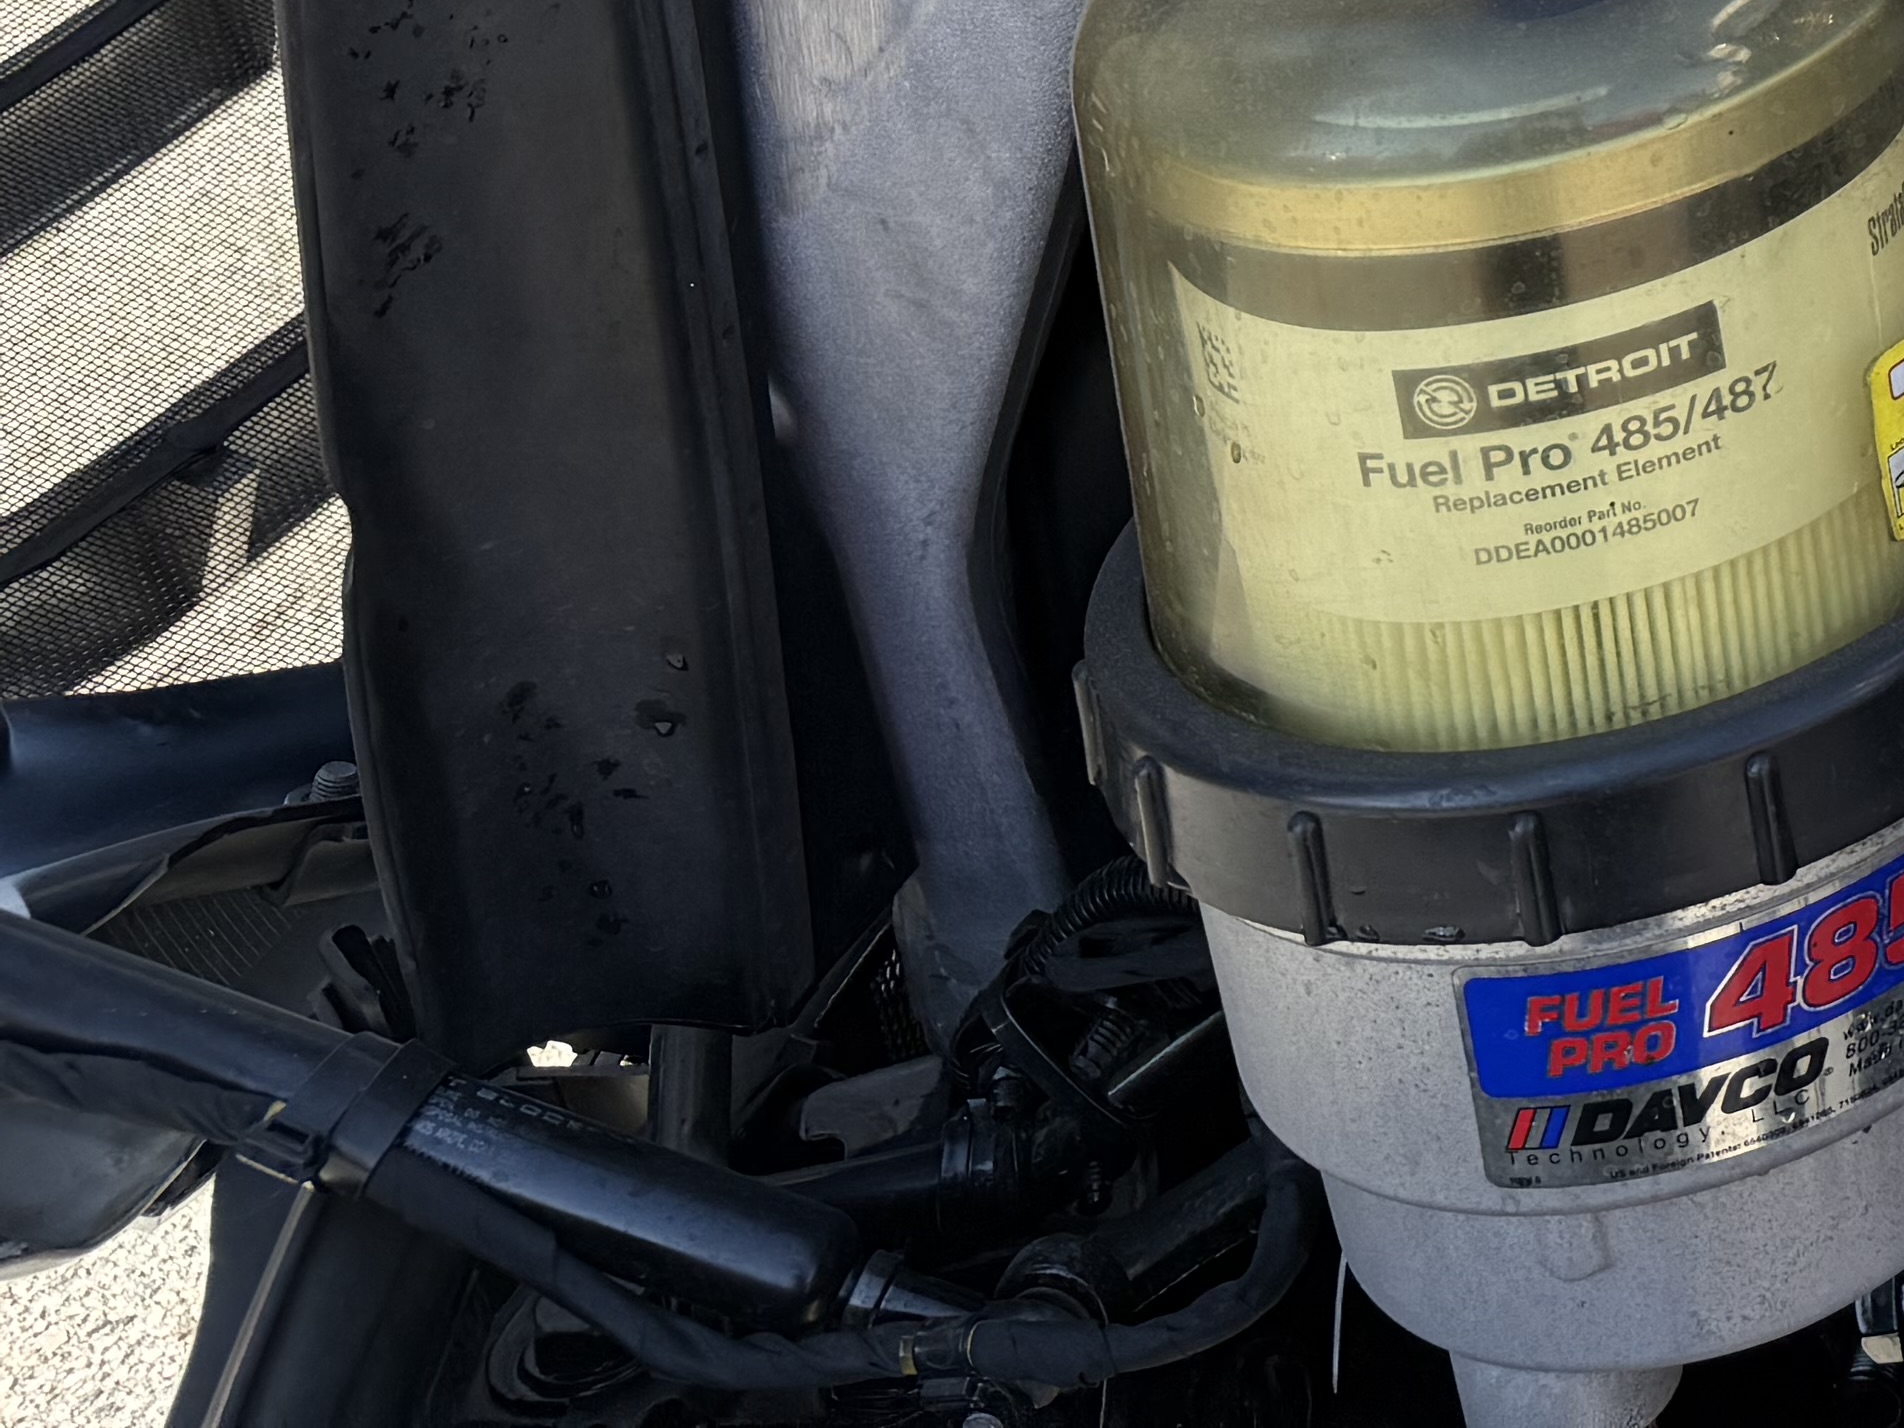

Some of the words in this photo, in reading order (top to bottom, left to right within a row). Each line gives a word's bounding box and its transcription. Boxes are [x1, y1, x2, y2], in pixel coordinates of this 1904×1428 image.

[1488, 333, 1699, 408] DETROIT
[1358, 449, 1463, 489] Fuel
[1480, 443, 1572, 482] Pro
[1591, 360, 1780, 456] 485/487
[1433, 470, 1609, 514] Replacement
[1617, 433, 1722, 481] Element
[1475, 499, 1700, 565] DDEA0001485007
[1524, 515, 1582, 536] Reorder
[1588, 502, 1617, 524] Part
[1622, 499, 1646, 515] No.
[1524, 975, 1679, 1036] FUEL
[1548, 1020, 1677, 1078] PRO
[1849, 1044, 1891, 1076] Made
[1571, 1036, 1829, 1146] DAVCO
[1752, 1089, 1809, 1123] LLC
[1610, 1170, 1626, 1180] US
[1628, 1164, 1651, 1177] and
[1652, 1155, 1694, 1172] Foreign
